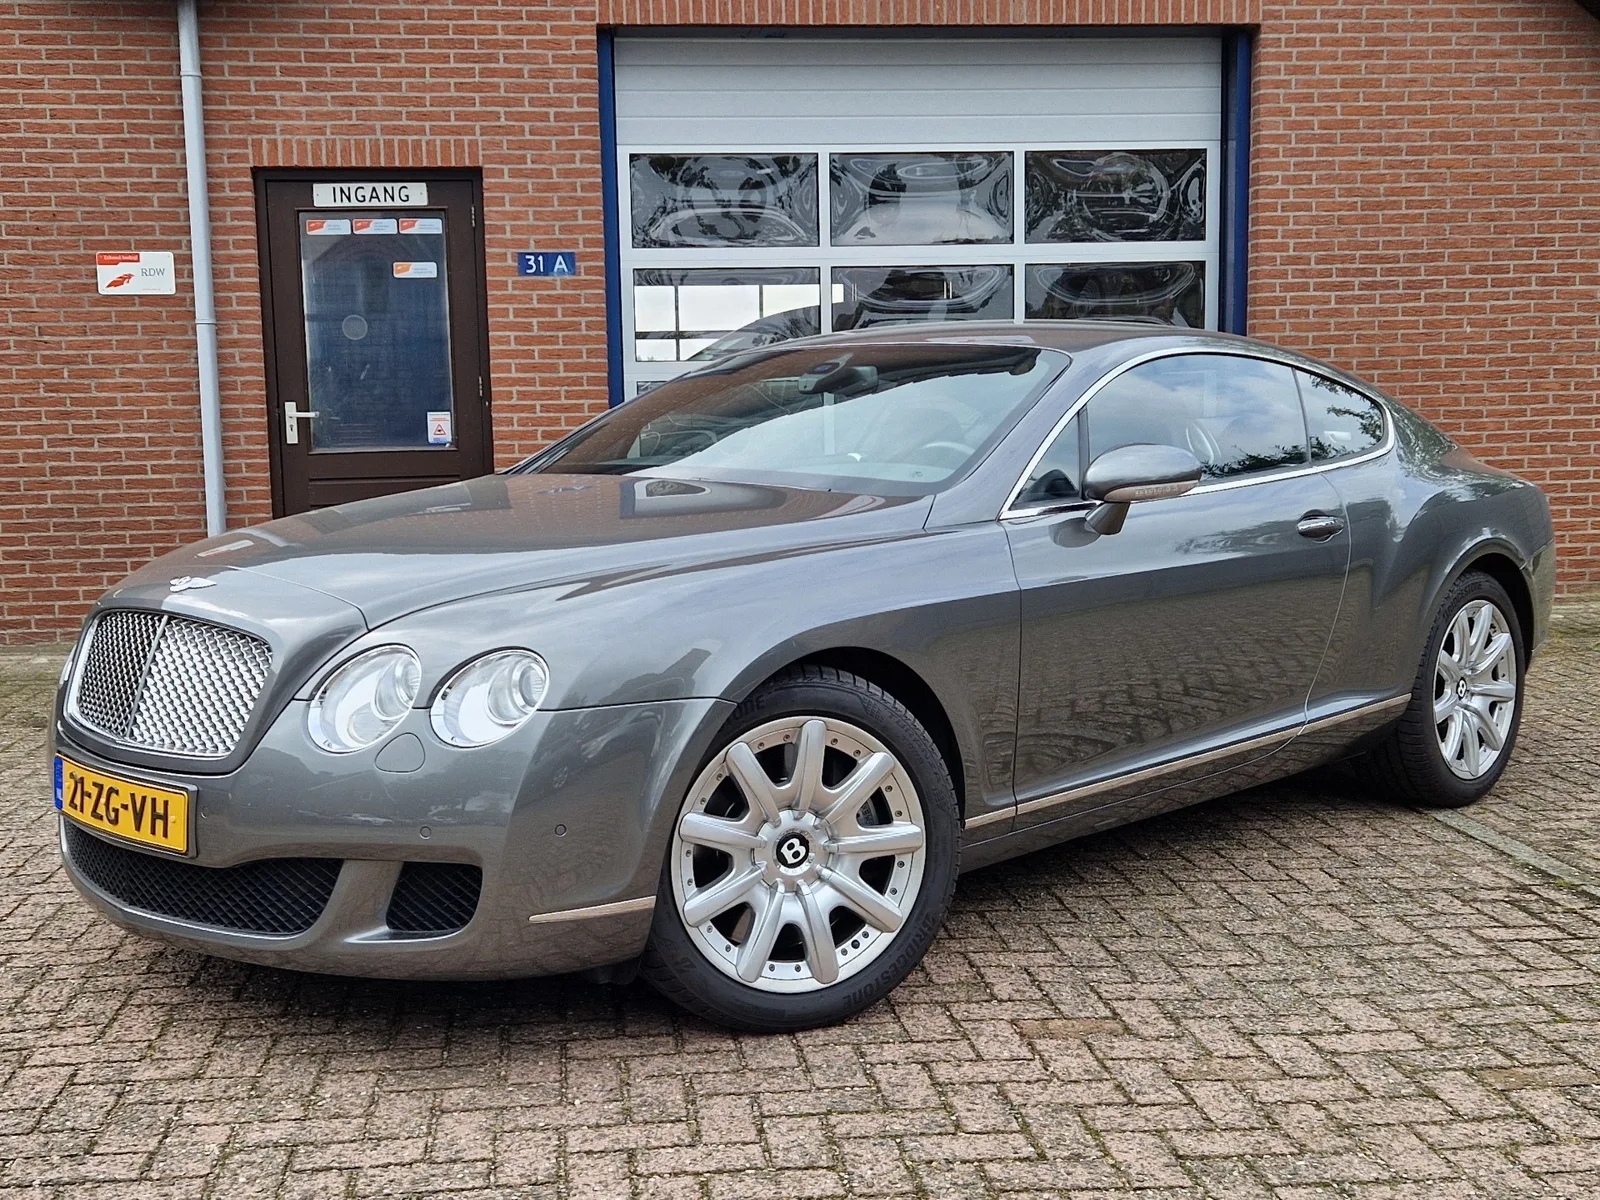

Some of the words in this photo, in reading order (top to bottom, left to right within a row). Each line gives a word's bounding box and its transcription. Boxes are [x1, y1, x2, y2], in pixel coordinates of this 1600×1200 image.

[332, 186, 410, 203] INGANG
[141, 268, 165, 277] RDW
[525, 254, 544, 273] 31
[553, 254, 569, 273] A
[68, 771, 170, 839] 21-ZG-VH
[842, 911, 939, 1010] BRIDGESTONE
